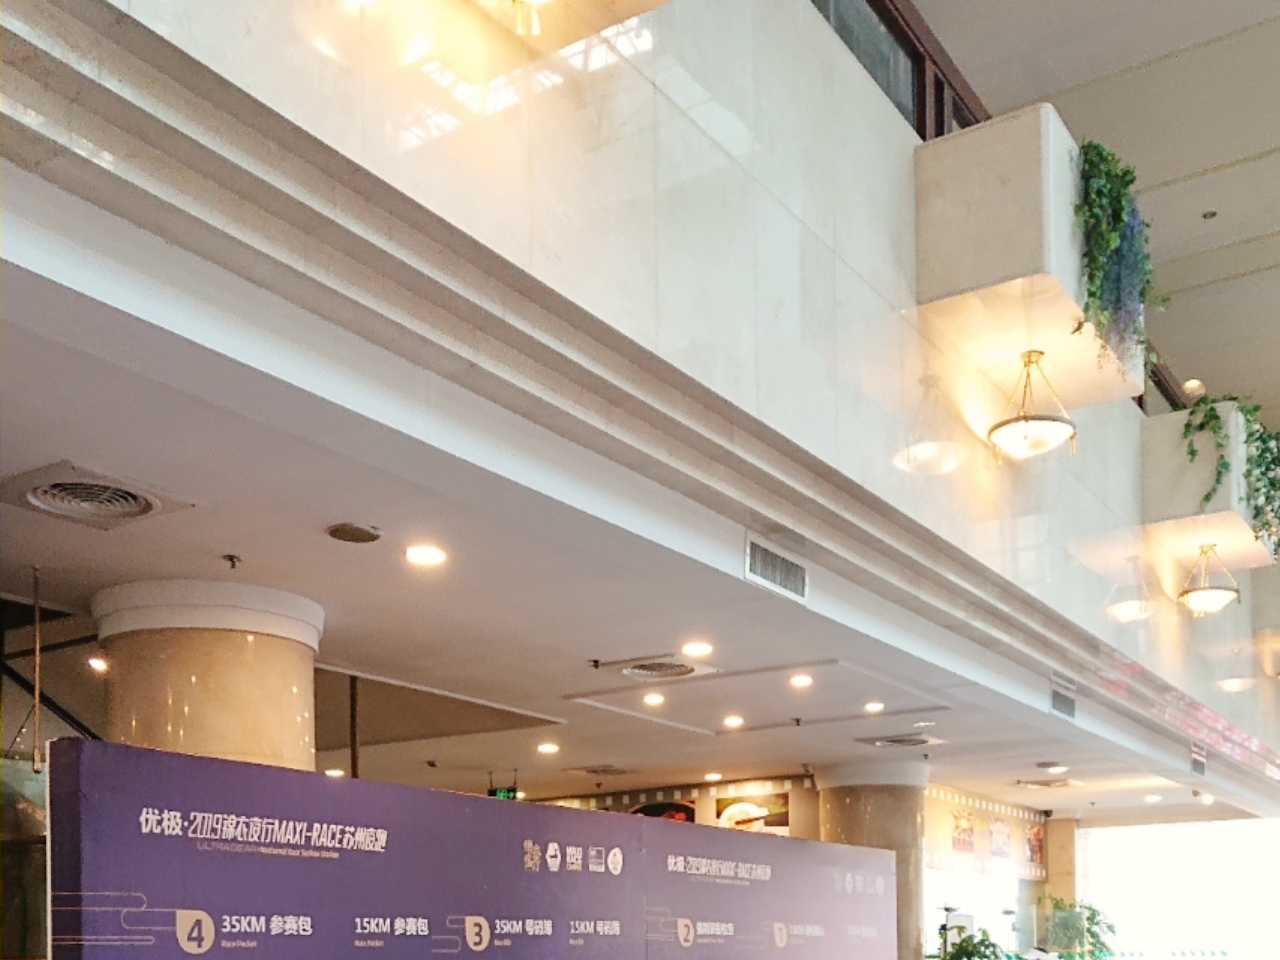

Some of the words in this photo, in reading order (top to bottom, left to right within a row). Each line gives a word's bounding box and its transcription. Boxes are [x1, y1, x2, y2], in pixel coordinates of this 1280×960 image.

[186, 919, 205, 949] 4
[221, 915, 266, 933] 35KM
[270, 914, 313, 936] 参赛包
[354, 917, 391, 934] 15KM
[393, 916, 429, 936] 参赛包
[472, 921, 484, 947] 3
[494, 919, 523, 934] 35KM
[569, 920, 595, 934] 15KM
[682, 923, 691, 943] 2
